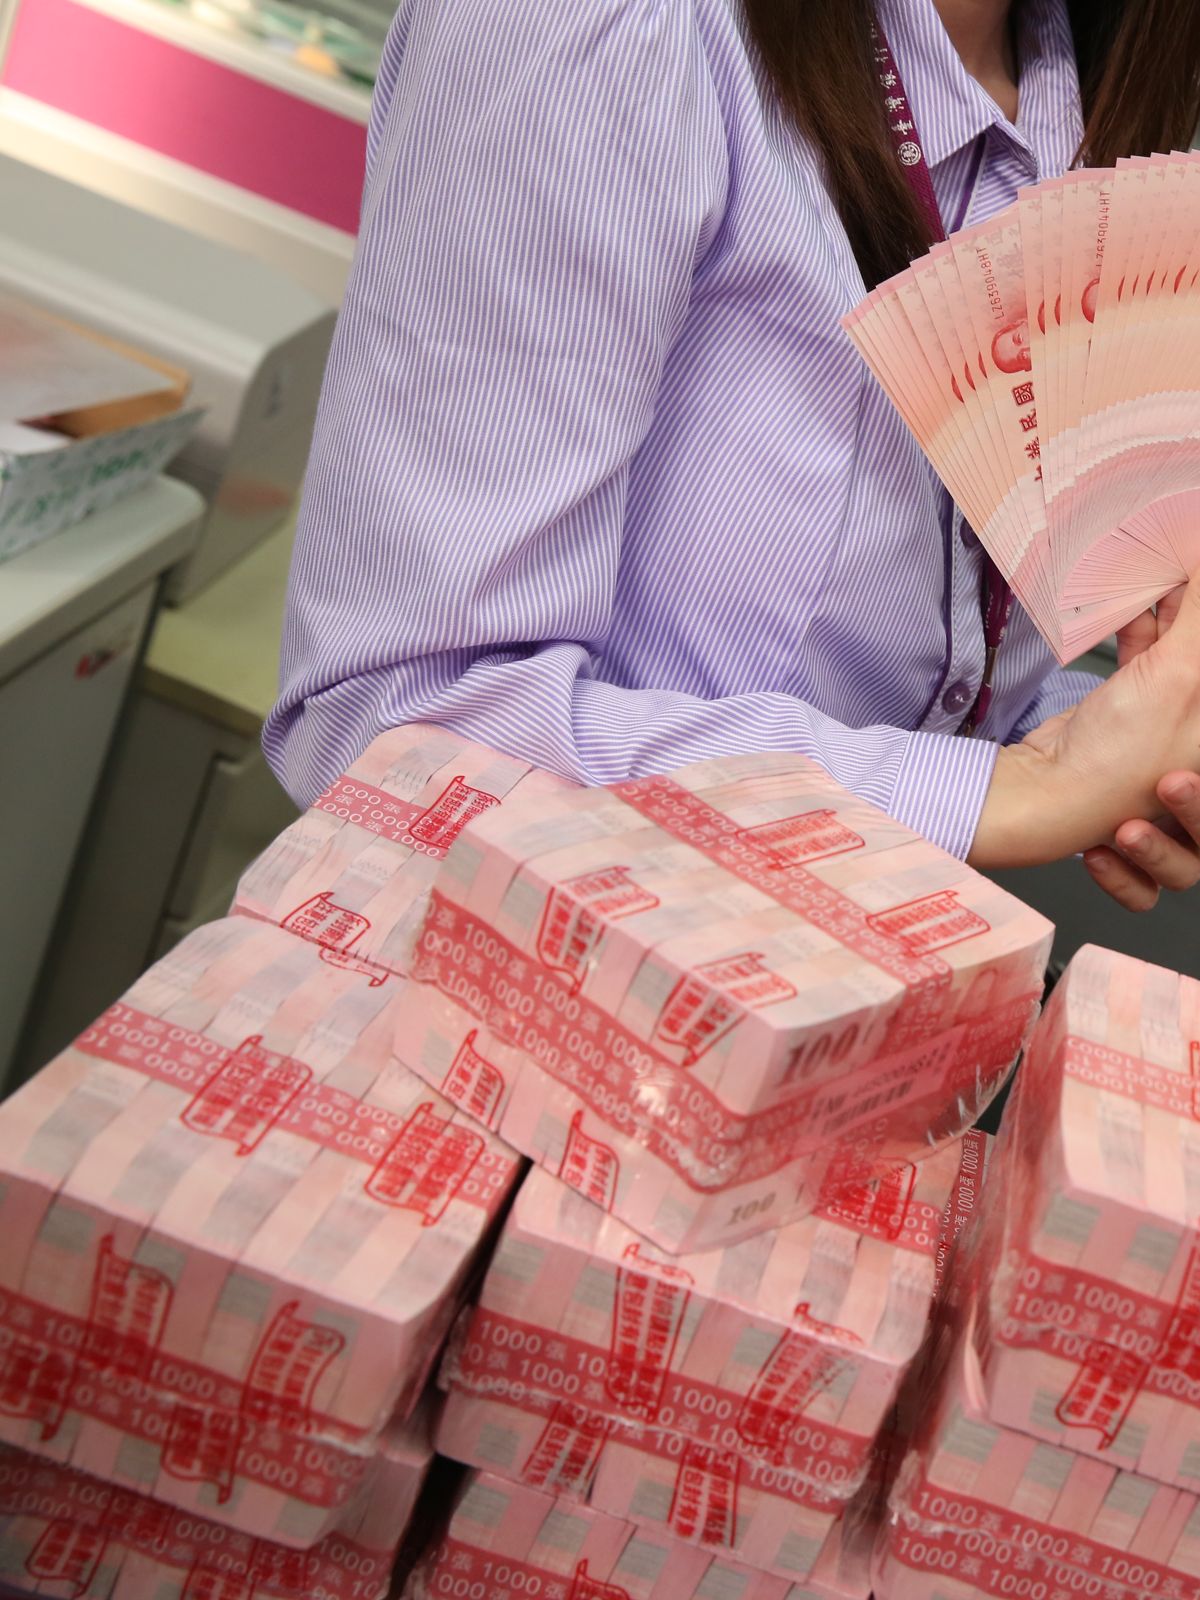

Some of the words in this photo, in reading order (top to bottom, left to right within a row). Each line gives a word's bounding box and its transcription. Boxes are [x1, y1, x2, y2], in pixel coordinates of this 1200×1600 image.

[977, 247, 1004, 320] LZ639048HT
[331, 780, 382, 805] 1000
[313, 799, 363, 823] 1000
[391, 831, 440, 858] 1000
[361, 804, 410, 831] 1000
[423, 931, 465, 966] 000
[487, 972, 536, 1017] 1000
[557, 1024, 605, 1070] 1000
[464, 922, 509, 960] 1000
[532, 974, 581, 1023] 1000
[605, 1027, 654, 1074] 1000
[447, 970, 491, 1015] 1000
[513, 1023, 561, 1067] 1000
[167, 1027, 228, 1060] 1000
[108, 1022, 173, 1054] 1000
[300, 1097, 360, 1131] 1000
[144, 1052, 206, 1086] 1000
[962, 1149, 979, 1175] 1000
[957, 1187, 975, 1213] 1000
[1014, 1293, 1076, 1325] 1000
[1073, 1282, 1136, 1321] 1000
[151, 1358, 217, 1398] 1000
[480, 1320, 542, 1355] 1000
[671, 1384, 733, 1420] 1000
[520, 1357, 581, 1395] 1000
[749, 1463, 810, 1499] 1000
[176, 1519, 226, 1545] 000
[319, 1539, 376, 1577] 1000
[919, 1491, 977, 1525] 1000
[1010, 1523, 1069, 1557] 1000
[1099, 1555, 1161, 1590] 1000
[483, 1561, 542, 1596] 1000
[899, 1536, 957, 1569] 1000
[989, 1567, 1047, 1600] 1000
[953, 1529, 1012, 1564] 1000
[1043, 1558, 1102, 1597] 1000
